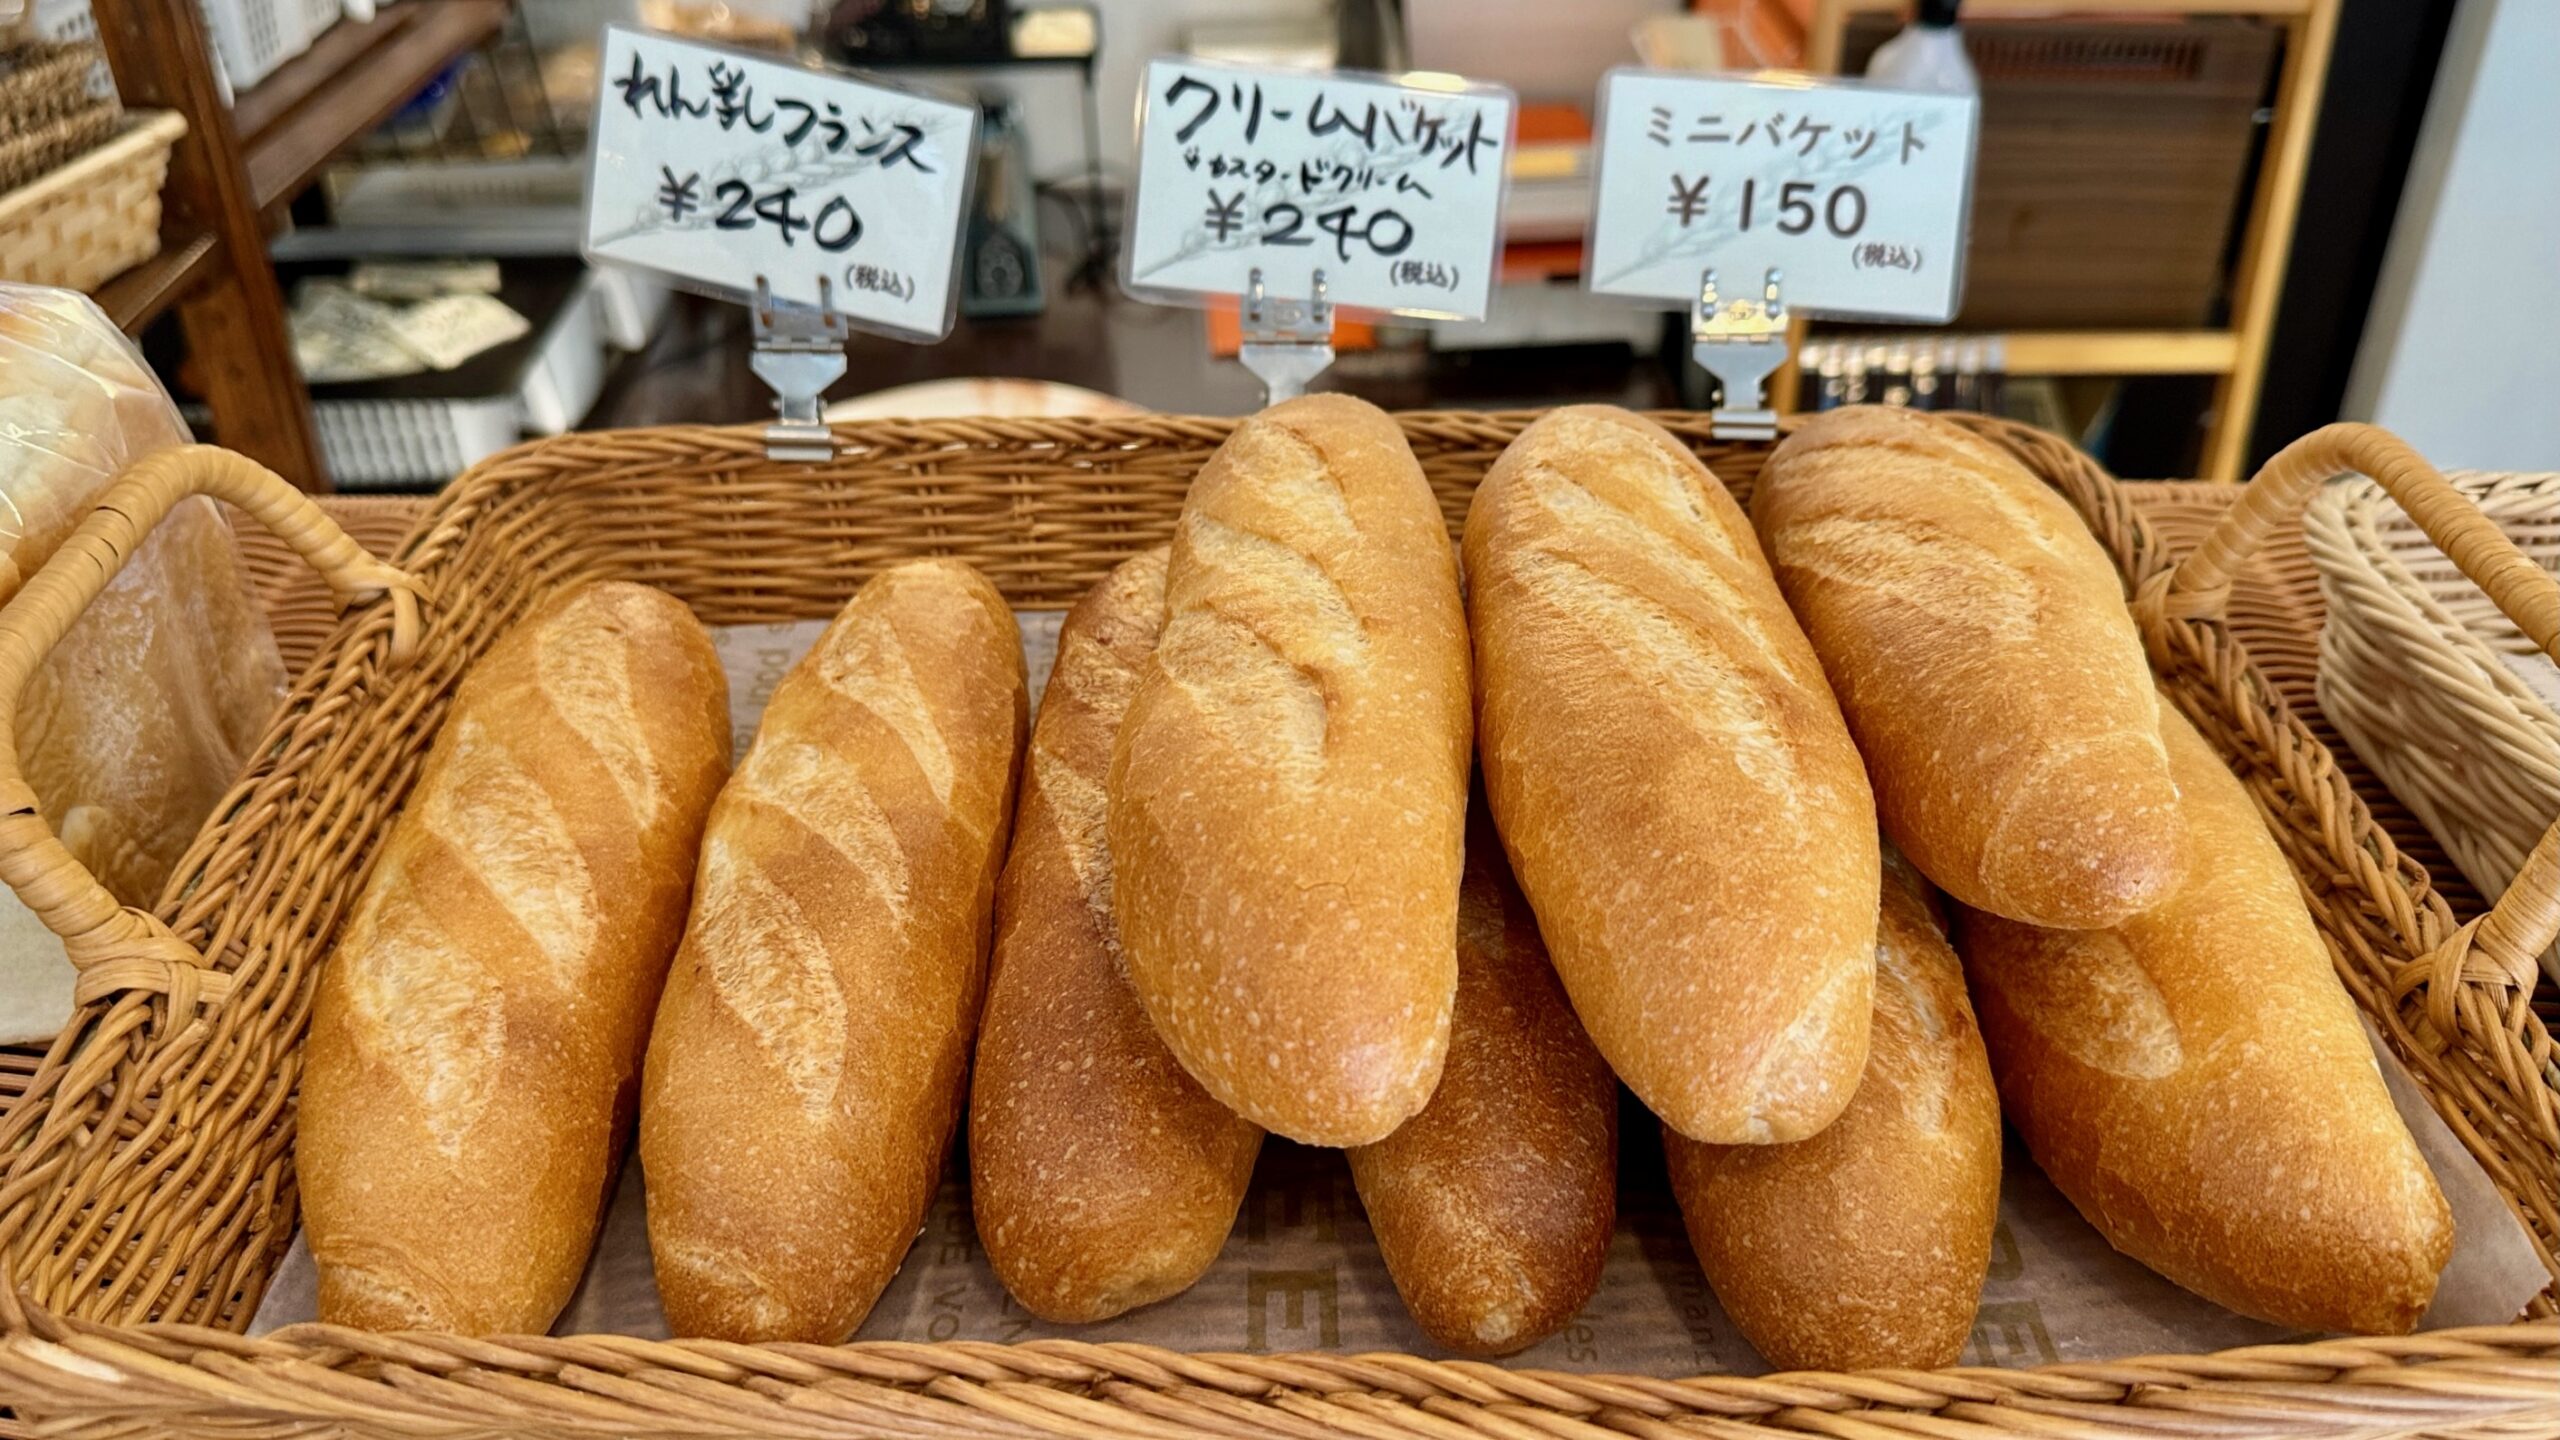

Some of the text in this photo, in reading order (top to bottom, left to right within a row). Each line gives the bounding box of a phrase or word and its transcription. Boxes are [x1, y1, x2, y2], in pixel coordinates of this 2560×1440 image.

[613, 50, 935, 174] れん乳フランス
[1164, 74, 1498, 175] クリームバケット
[1647, 106, 1926, 165] ミニバケット
[1389, 260, 1460, 292] (税込)
